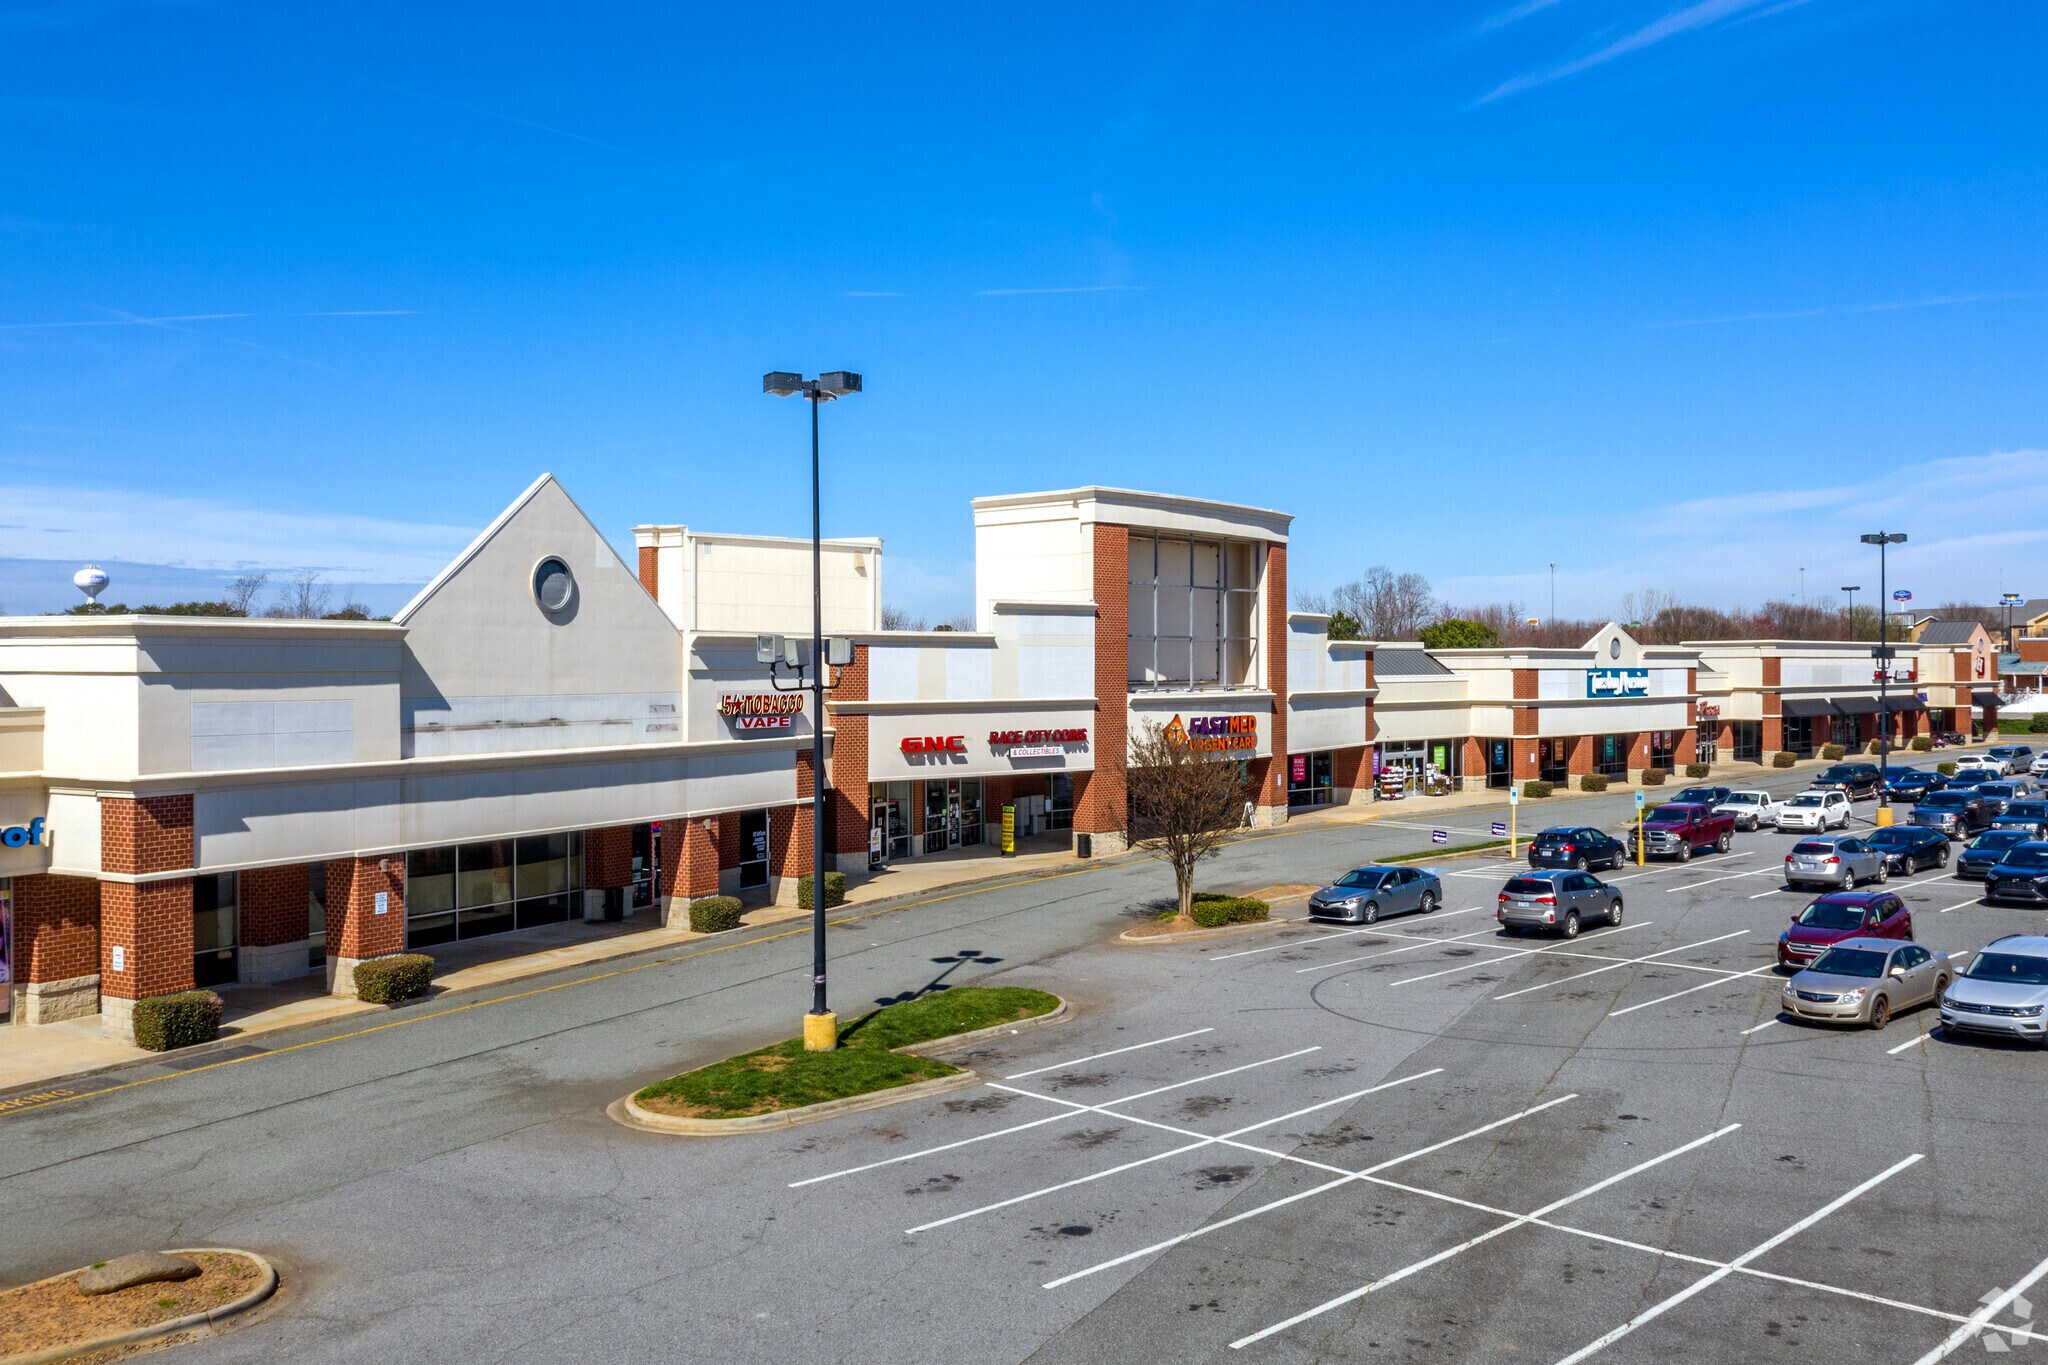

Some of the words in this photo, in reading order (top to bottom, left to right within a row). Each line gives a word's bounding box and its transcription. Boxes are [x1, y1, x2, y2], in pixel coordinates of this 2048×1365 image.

[744, 693, 804, 714] TOBACCO
[740, 716, 790, 728] VAPE
[1189, 715, 1257, 735] FASTMED
[901, 735, 965, 752] GNC
[989, 731, 1023, 744] RACE
[1025, 729, 1053, 743] CITY
[1053, 728, 1088, 742] COINS
[1232, 735, 1257, 750] CARE
[1018, 748, 1060, 756] COLLECTIBLES
[0, 816, 45, 848] of
